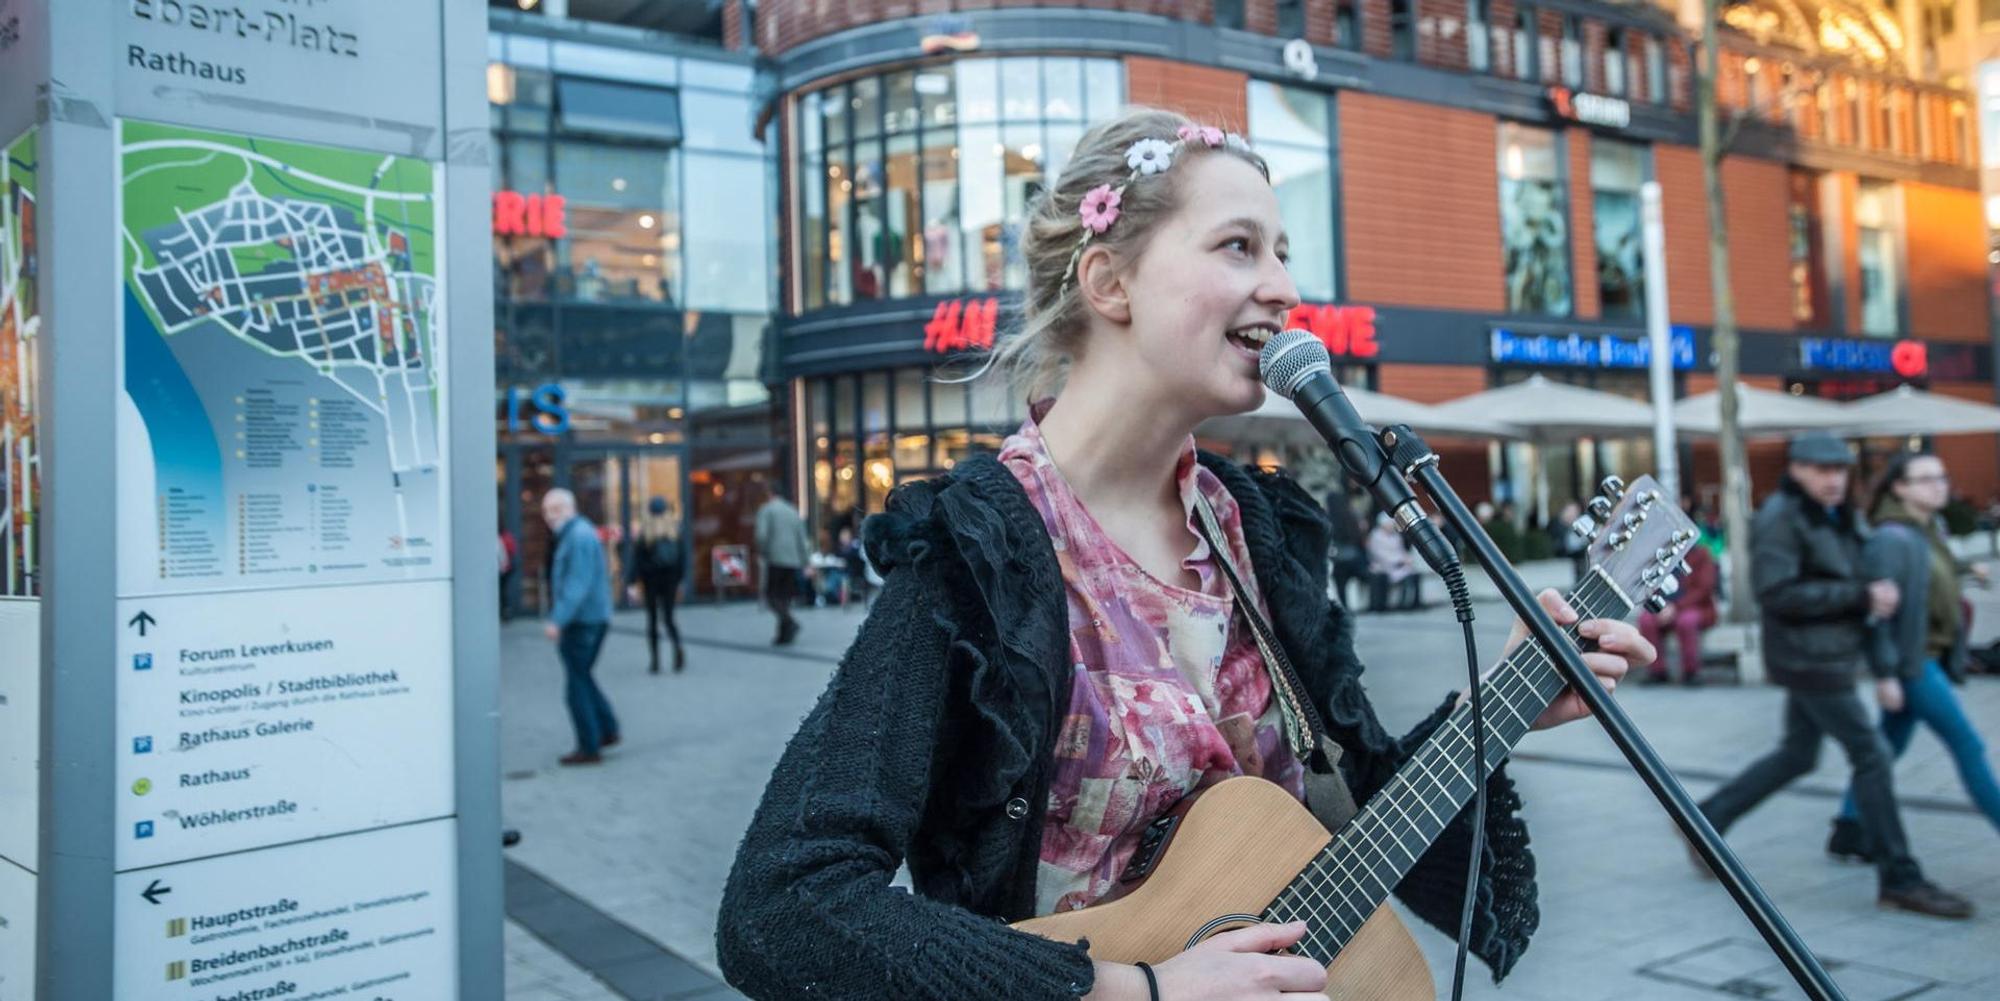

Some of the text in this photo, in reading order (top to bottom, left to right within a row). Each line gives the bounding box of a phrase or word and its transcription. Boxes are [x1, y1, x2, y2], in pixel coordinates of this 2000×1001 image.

[128, 44, 247, 84] Rathaus
[491, 189, 567, 238] RIE
[507, 384, 571, 435] IS
[179, 638, 334, 663] Forum Leverkusen
[179, 684, 261, 704] Kinopolis
[278, 669, 399, 694] Stadtbibliothek
[179, 718, 315, 747] Rathaus Galerie
[179, 767, 251, 788] Rathaus
[179, 800, 298, 830] Wöhlerstraße
[191, 898, 299, 931] Hauptstraße
[190, 928, 349, 973] Breidenbachstraße
